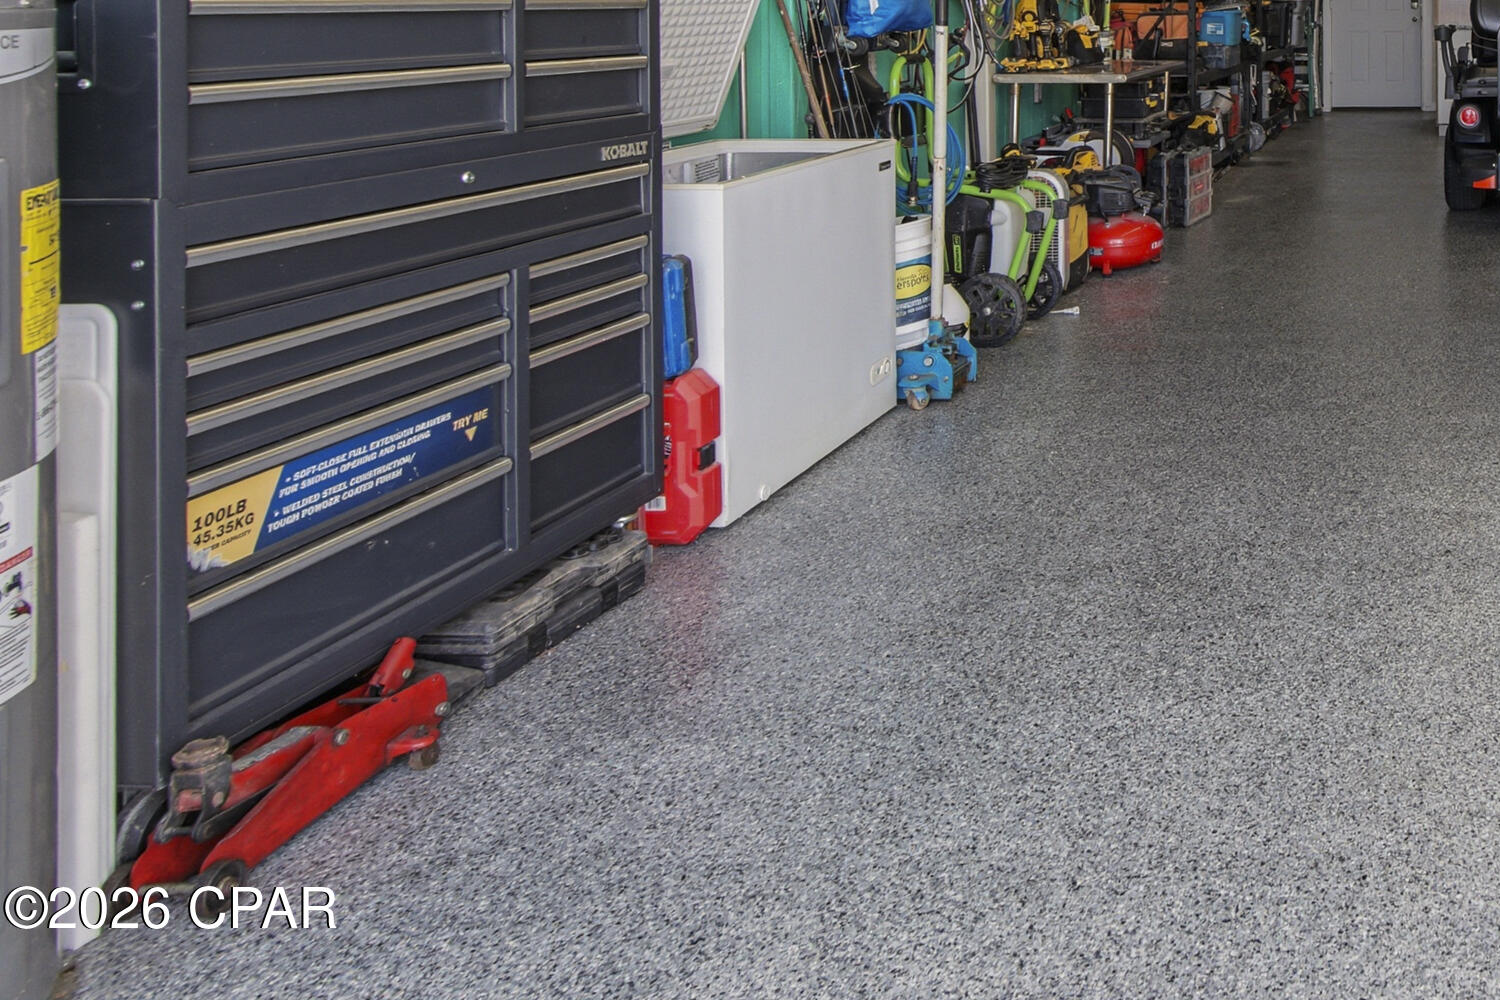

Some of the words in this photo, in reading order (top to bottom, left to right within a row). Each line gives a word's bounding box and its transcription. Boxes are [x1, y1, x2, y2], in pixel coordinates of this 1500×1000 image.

[601, 140, 648, 161] KOBALT
[452, 414, 472, 432] TRY
[473, 408, 489, 423] ME
[278, 483, 299, 499] FOR
[300, 468, 339, 490] SMOOTH
[340, 452, 377, 474] OPENING
[378, 444, 396, 458] AND
[397, 430, 431, 450] CLOSING
[292, 453, 347, 481] SOFT-CLOSE
[347, 445, 368, 460] FULL
[369, 427, 414, 451] EXTENSION
[267, 511, 300, 533] TOUGH
[301, 495, 341, 519] POWDER
[342, 480, 375, 501] COATED
[282, 493, 321, 515] WELDED
[322, 481, 349, 499] STEEL
[191, 498, 247, 533] 100LB
[192, 512, 255, 546] 45.35KG
